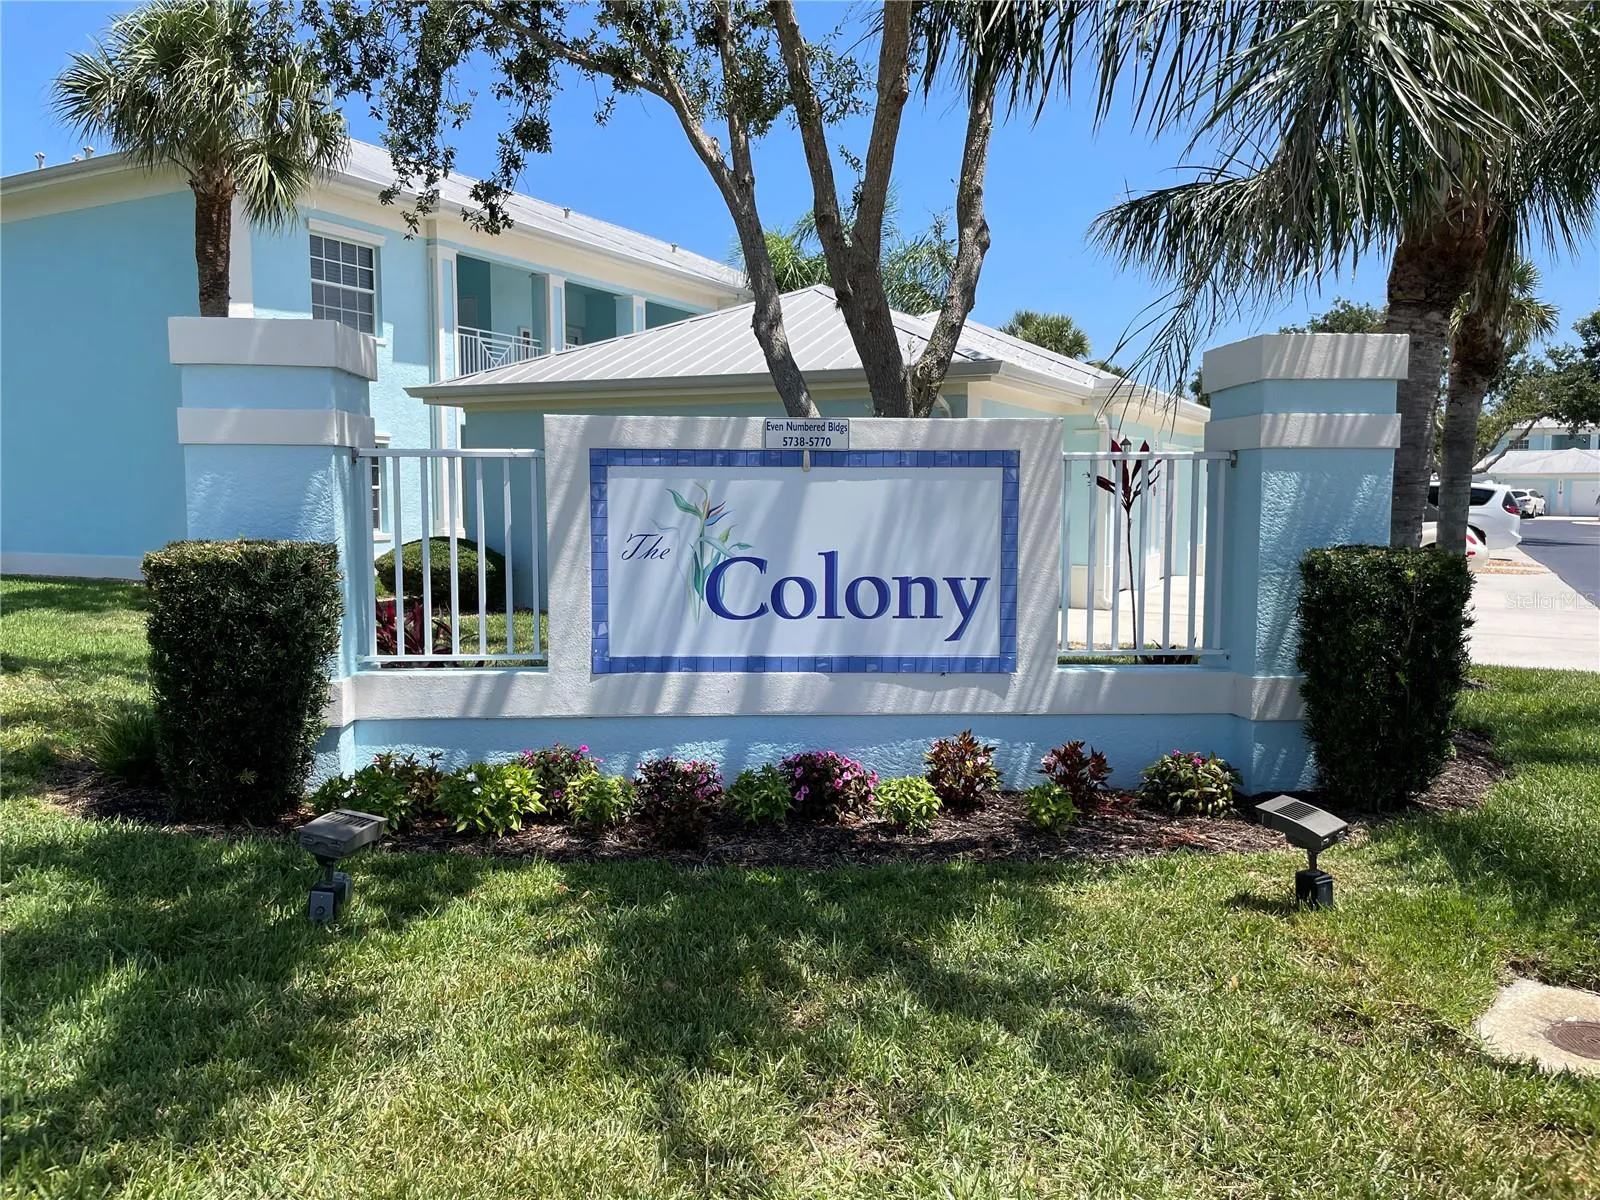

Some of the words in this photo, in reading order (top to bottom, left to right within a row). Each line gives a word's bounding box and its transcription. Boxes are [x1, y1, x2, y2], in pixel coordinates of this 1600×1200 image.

[766, 421, 784, 432] Even
[786, 421, 826, 432] Numbered
[828, 421, 848, 434] Bldgs
[782, 437, 832, 447] 5738-5770
[621, 533, 671, 561] The
[705, 550, 991, 642] Colony
